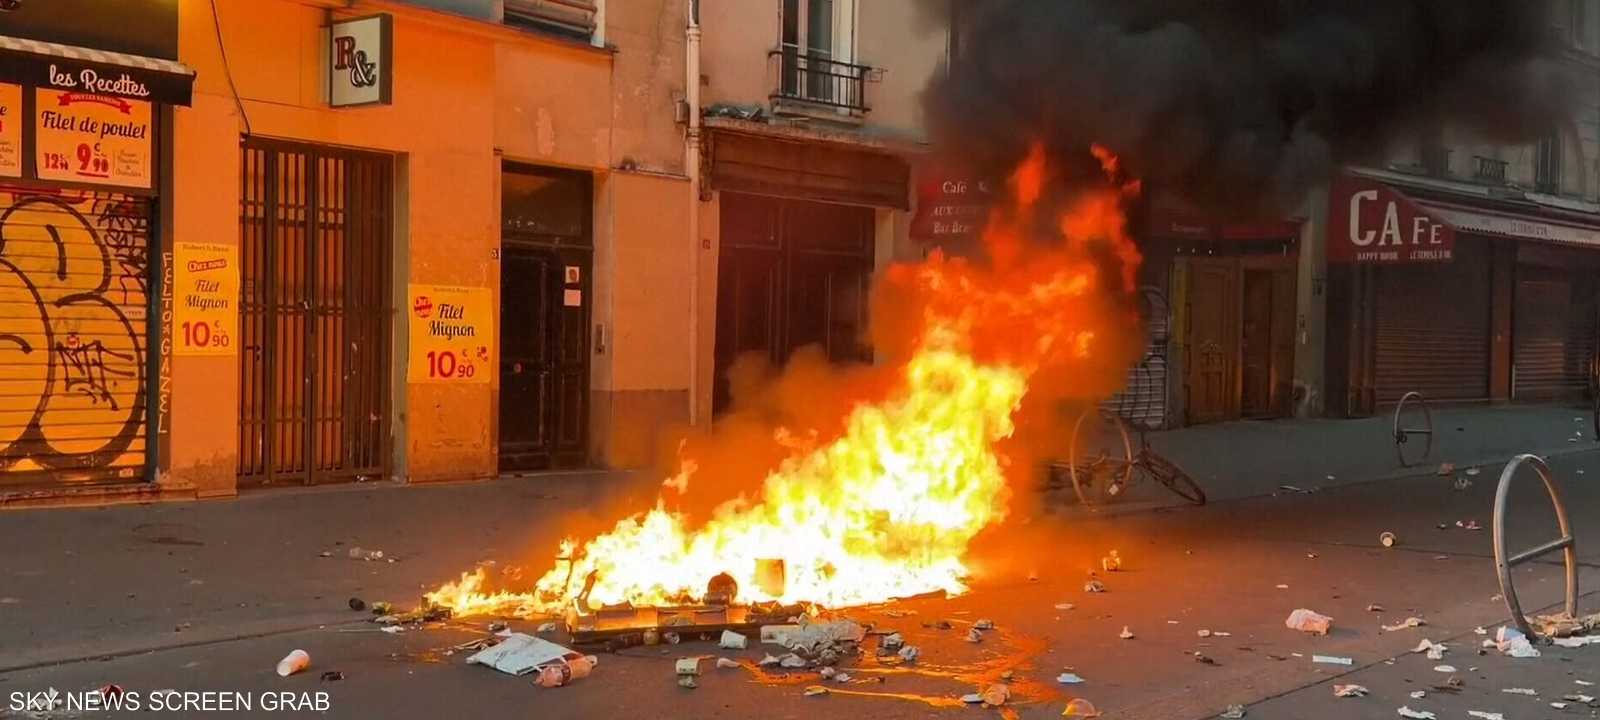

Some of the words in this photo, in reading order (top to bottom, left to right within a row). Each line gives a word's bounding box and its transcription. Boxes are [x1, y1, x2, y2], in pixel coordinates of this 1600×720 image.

[50, 64, 77, 87] les
[80, 69, 149, 97] Recettes
[41, 110, 75, 131] Filet
[79, 117, 98, 133] de
[100, 122, 147, 139] poulet
[194, 279, 220, 292] Filet
[185, 294, 228, 311] Mignon
[438, 303, 464, 319] Filet
[182, 321, 210, 347] 10
[212, 334, 229, 347] 90
[429, 320, 475, 340] Mignon
[427, 351, 456, 377] 10
[458, 364, 474, 378] 90
